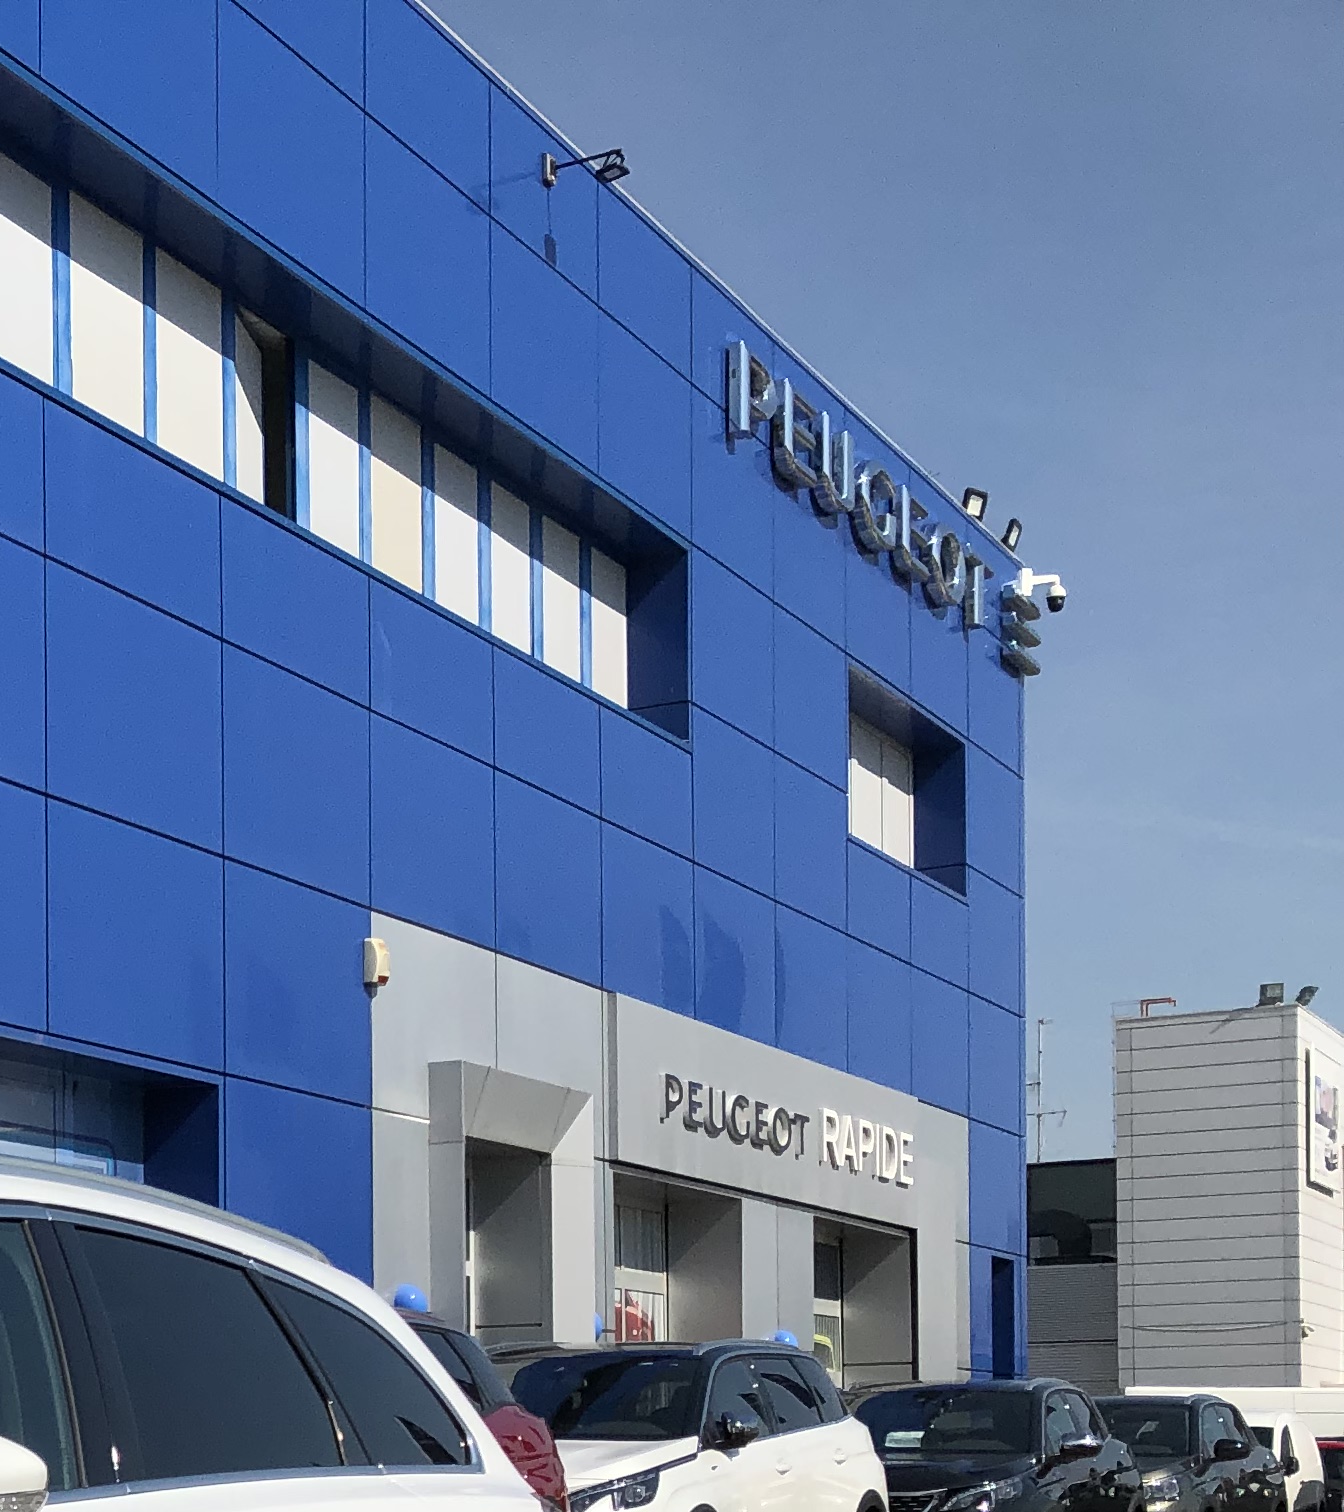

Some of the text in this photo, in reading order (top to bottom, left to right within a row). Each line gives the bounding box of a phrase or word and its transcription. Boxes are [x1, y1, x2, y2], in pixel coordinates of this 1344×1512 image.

[726, 339, 994, 630] PEUGEOT
[661, 1073, 914, 1186] PEUGEOT RAPIDE
